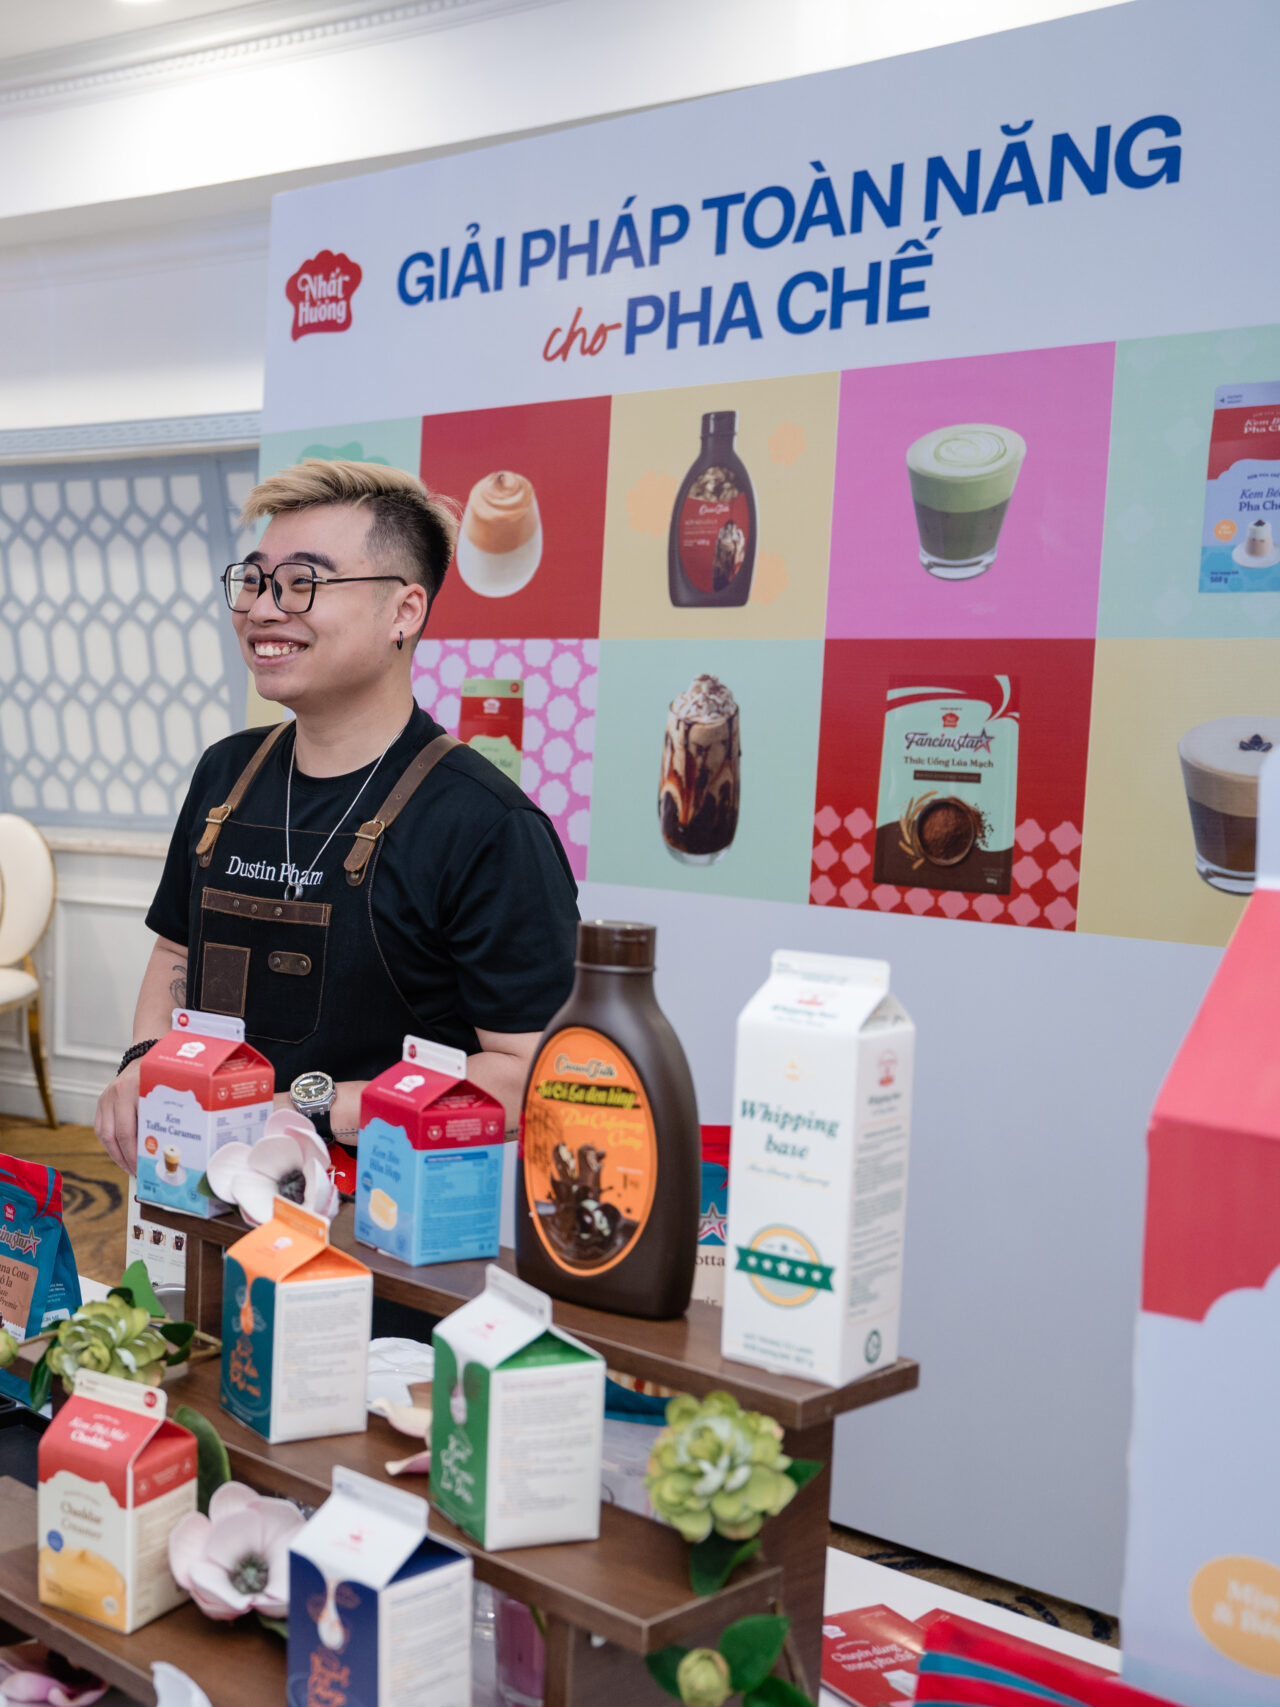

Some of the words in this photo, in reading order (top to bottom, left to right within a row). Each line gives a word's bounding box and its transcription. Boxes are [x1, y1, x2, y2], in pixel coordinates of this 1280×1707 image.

[397, 223, 504, 305] GIẢI
[520, 196, 690, 286] PHÁP
[702, 161, 905, 255] TOÀN
[923, 114, 1183, 222] NĂNG
[297, 267, 350, 302] Nhất
[542, 306, 622, 361] cho
[624, 281, 763, 355] PHA
[777, 227, 942, 334] CHẾ
[1239, 501, 1260, 512] Pha
[225, 856, 276, 882] Dustin
[278, 863, 324, 886] Pham
[740, 1099, 840, 1138] Whipping
[765, 1134, 808, 1159] base
[12, 1265, 30, 1281] Cotta
